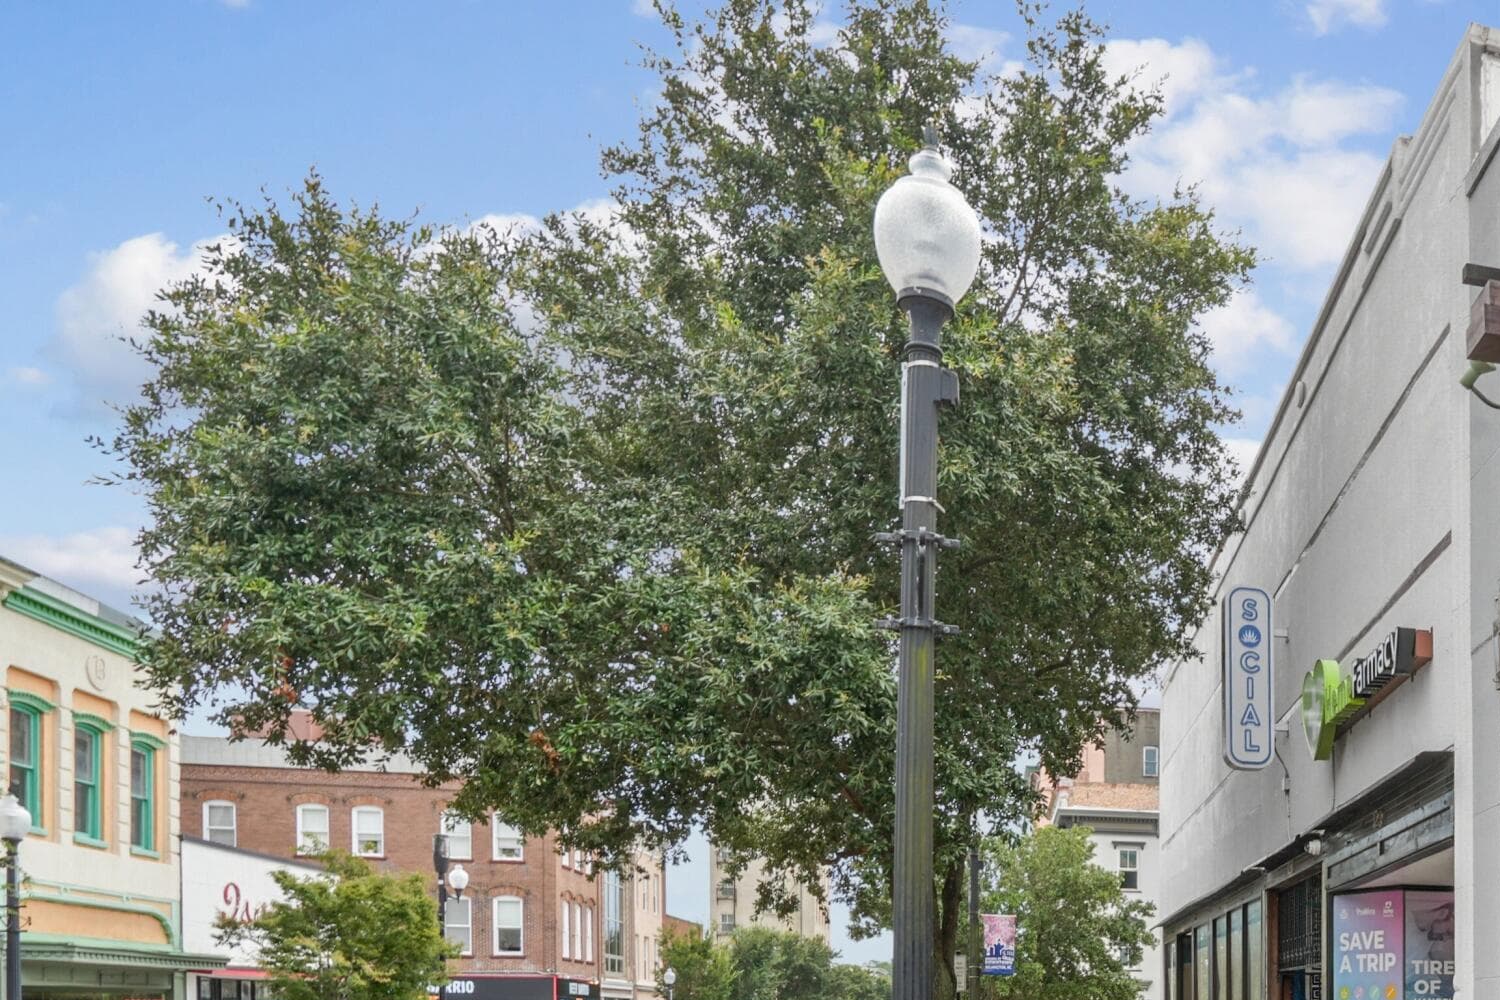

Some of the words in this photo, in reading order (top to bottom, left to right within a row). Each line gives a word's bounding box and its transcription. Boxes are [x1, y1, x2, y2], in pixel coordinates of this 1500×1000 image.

[1340, 930, 1384, 951] SAVE
[1340, 953, 1352, 973] A
[1355, 951, 1397, 973] TRIP
[1413, 980, 1442, 995] OF
